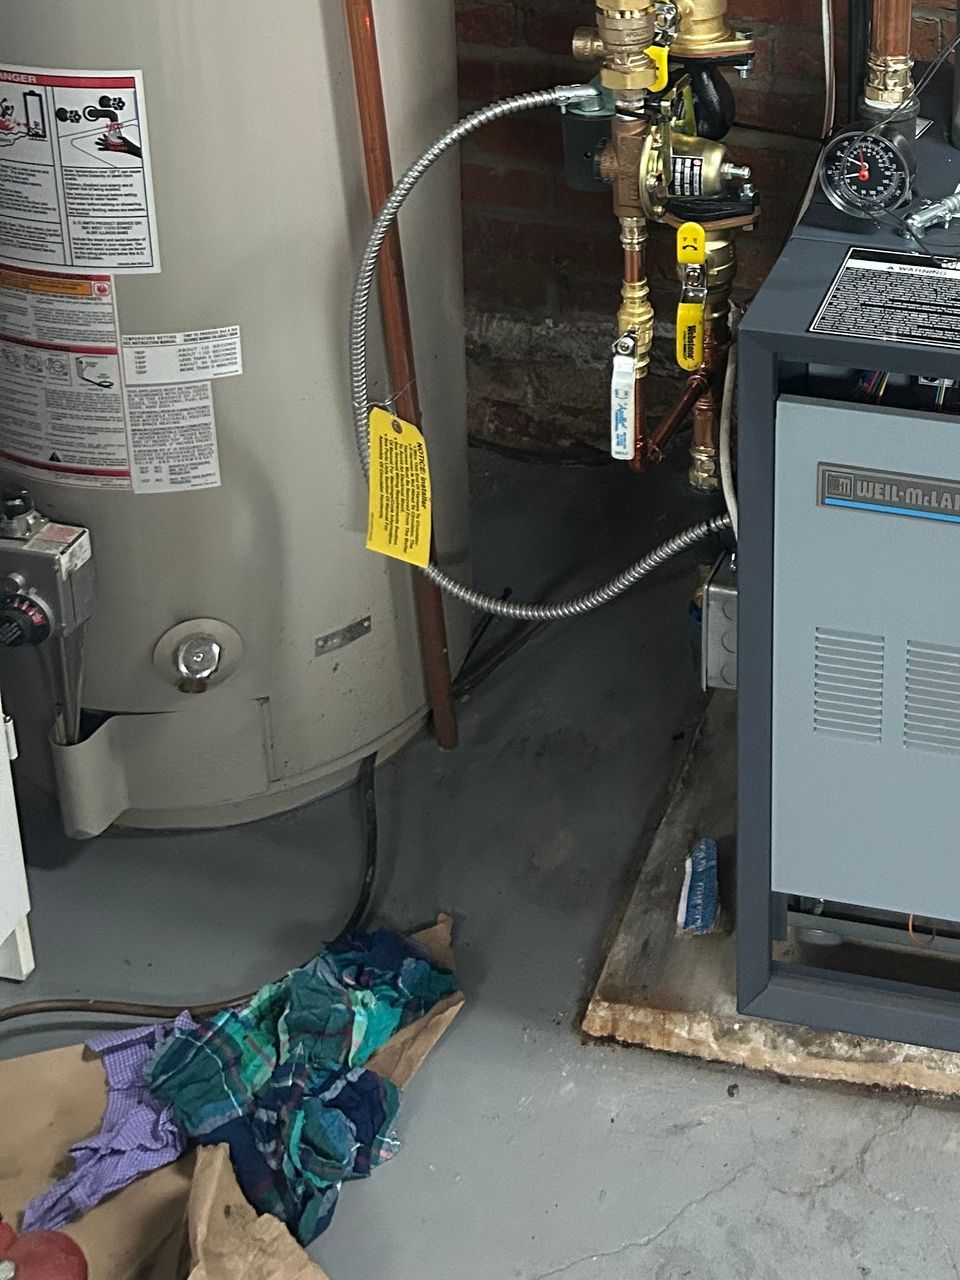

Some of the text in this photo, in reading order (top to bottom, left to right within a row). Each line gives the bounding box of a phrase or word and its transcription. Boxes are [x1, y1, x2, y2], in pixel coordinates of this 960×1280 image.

[899, 266, 948, 276] WARNING
[687, 325, 697, 360] Webstone
[420, 477, 428, 509] Installer
